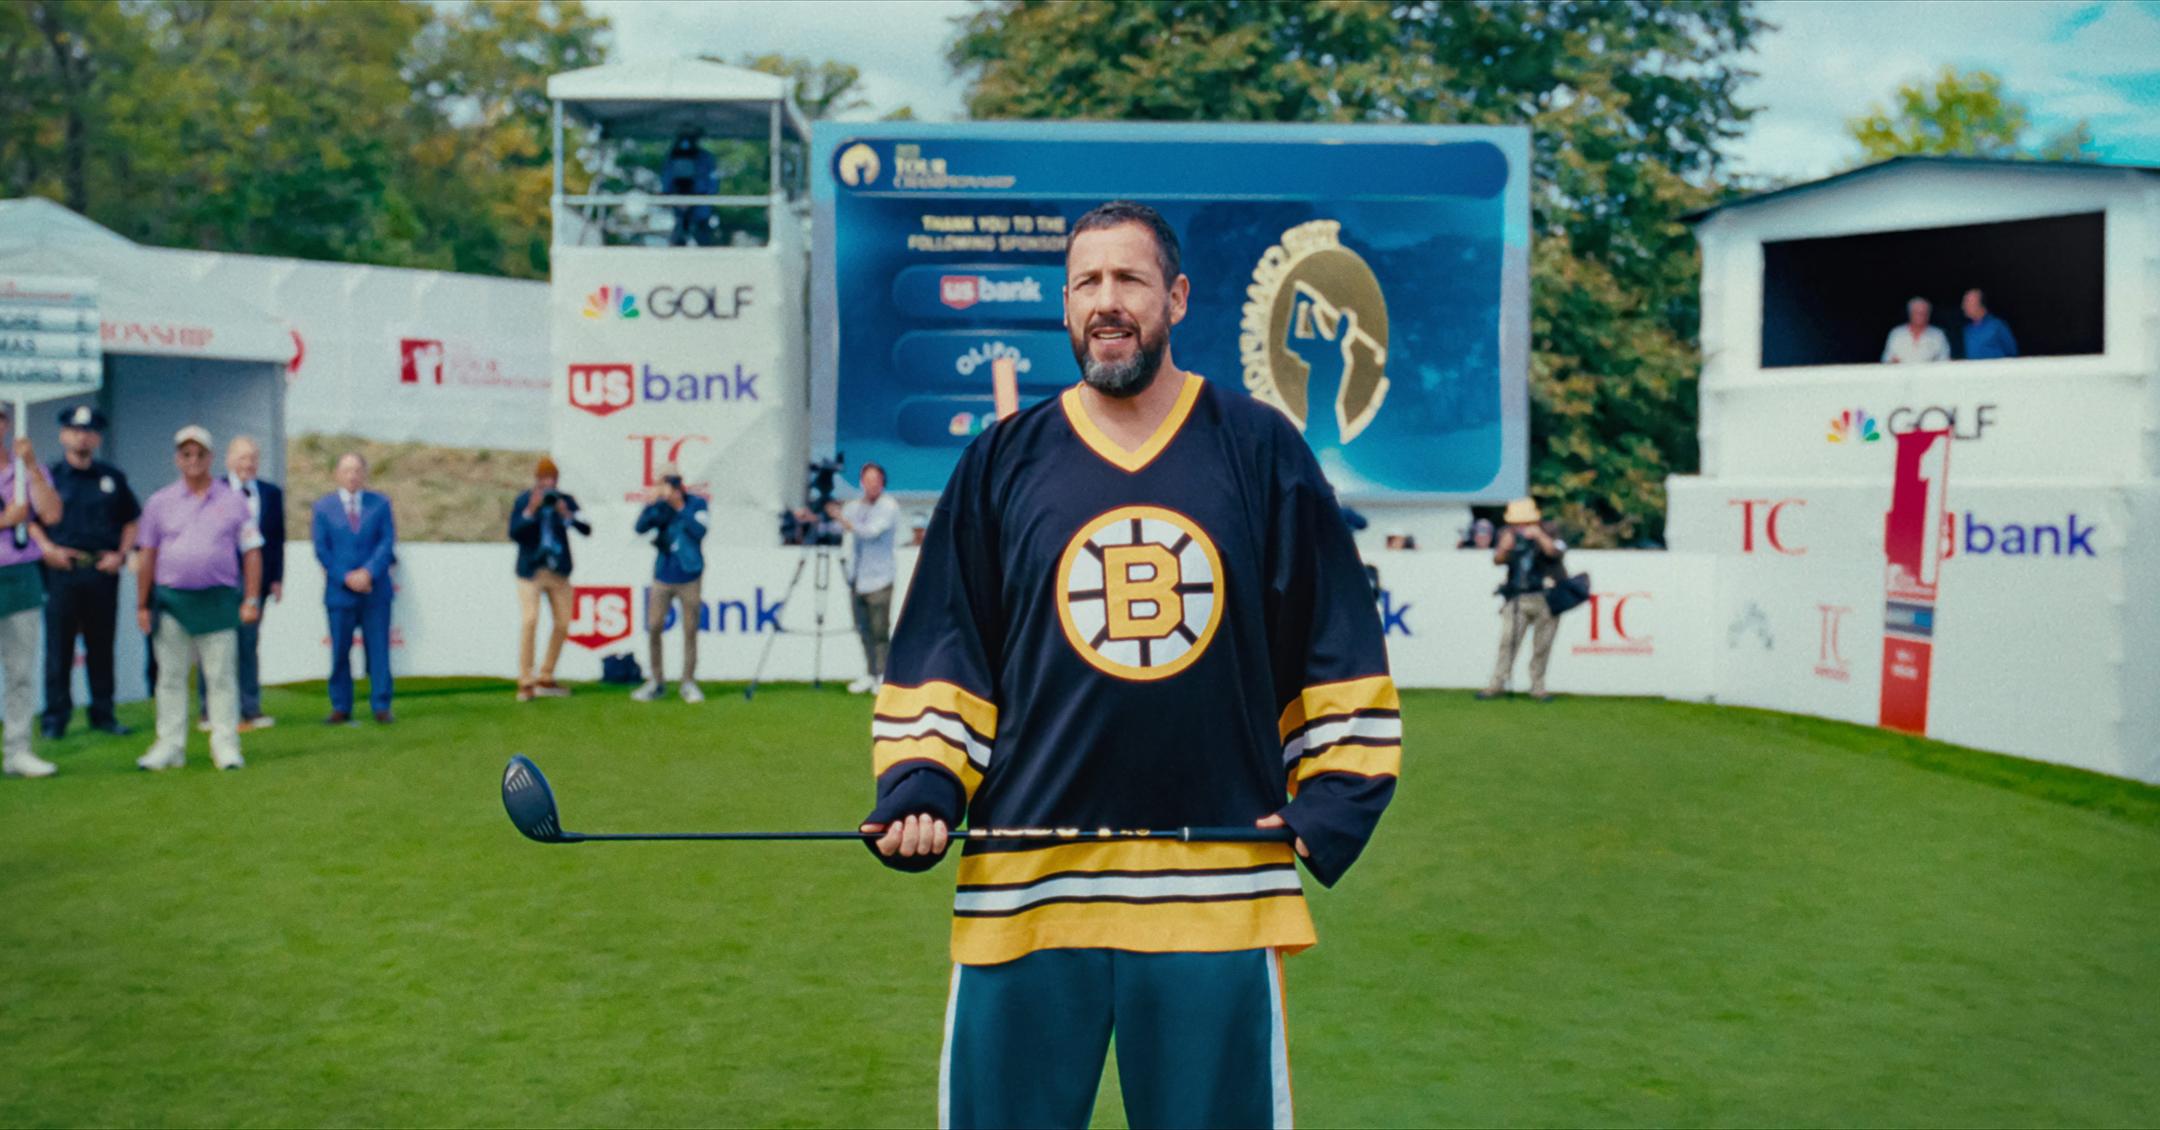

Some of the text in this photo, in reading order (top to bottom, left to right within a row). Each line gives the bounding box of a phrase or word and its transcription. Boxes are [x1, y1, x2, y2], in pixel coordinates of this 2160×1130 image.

[908, 234, 1068, 251] FOLLOWING SPONSOR
[922, 215, 1066, 233] THANK YOU TO THE
[647, 286, 754, 320] GOLF
[979, 276, 1042, 302] bank
[643, 363, 759, 401] bank
[1888, 404, 1998, 440] GOLF
[1728, 498, 1807, 555] TC
[1918, 435, 1948, 583] 1
[1965, 512, 2096, 557] bank
[1102, 542, 1184, 641] B
